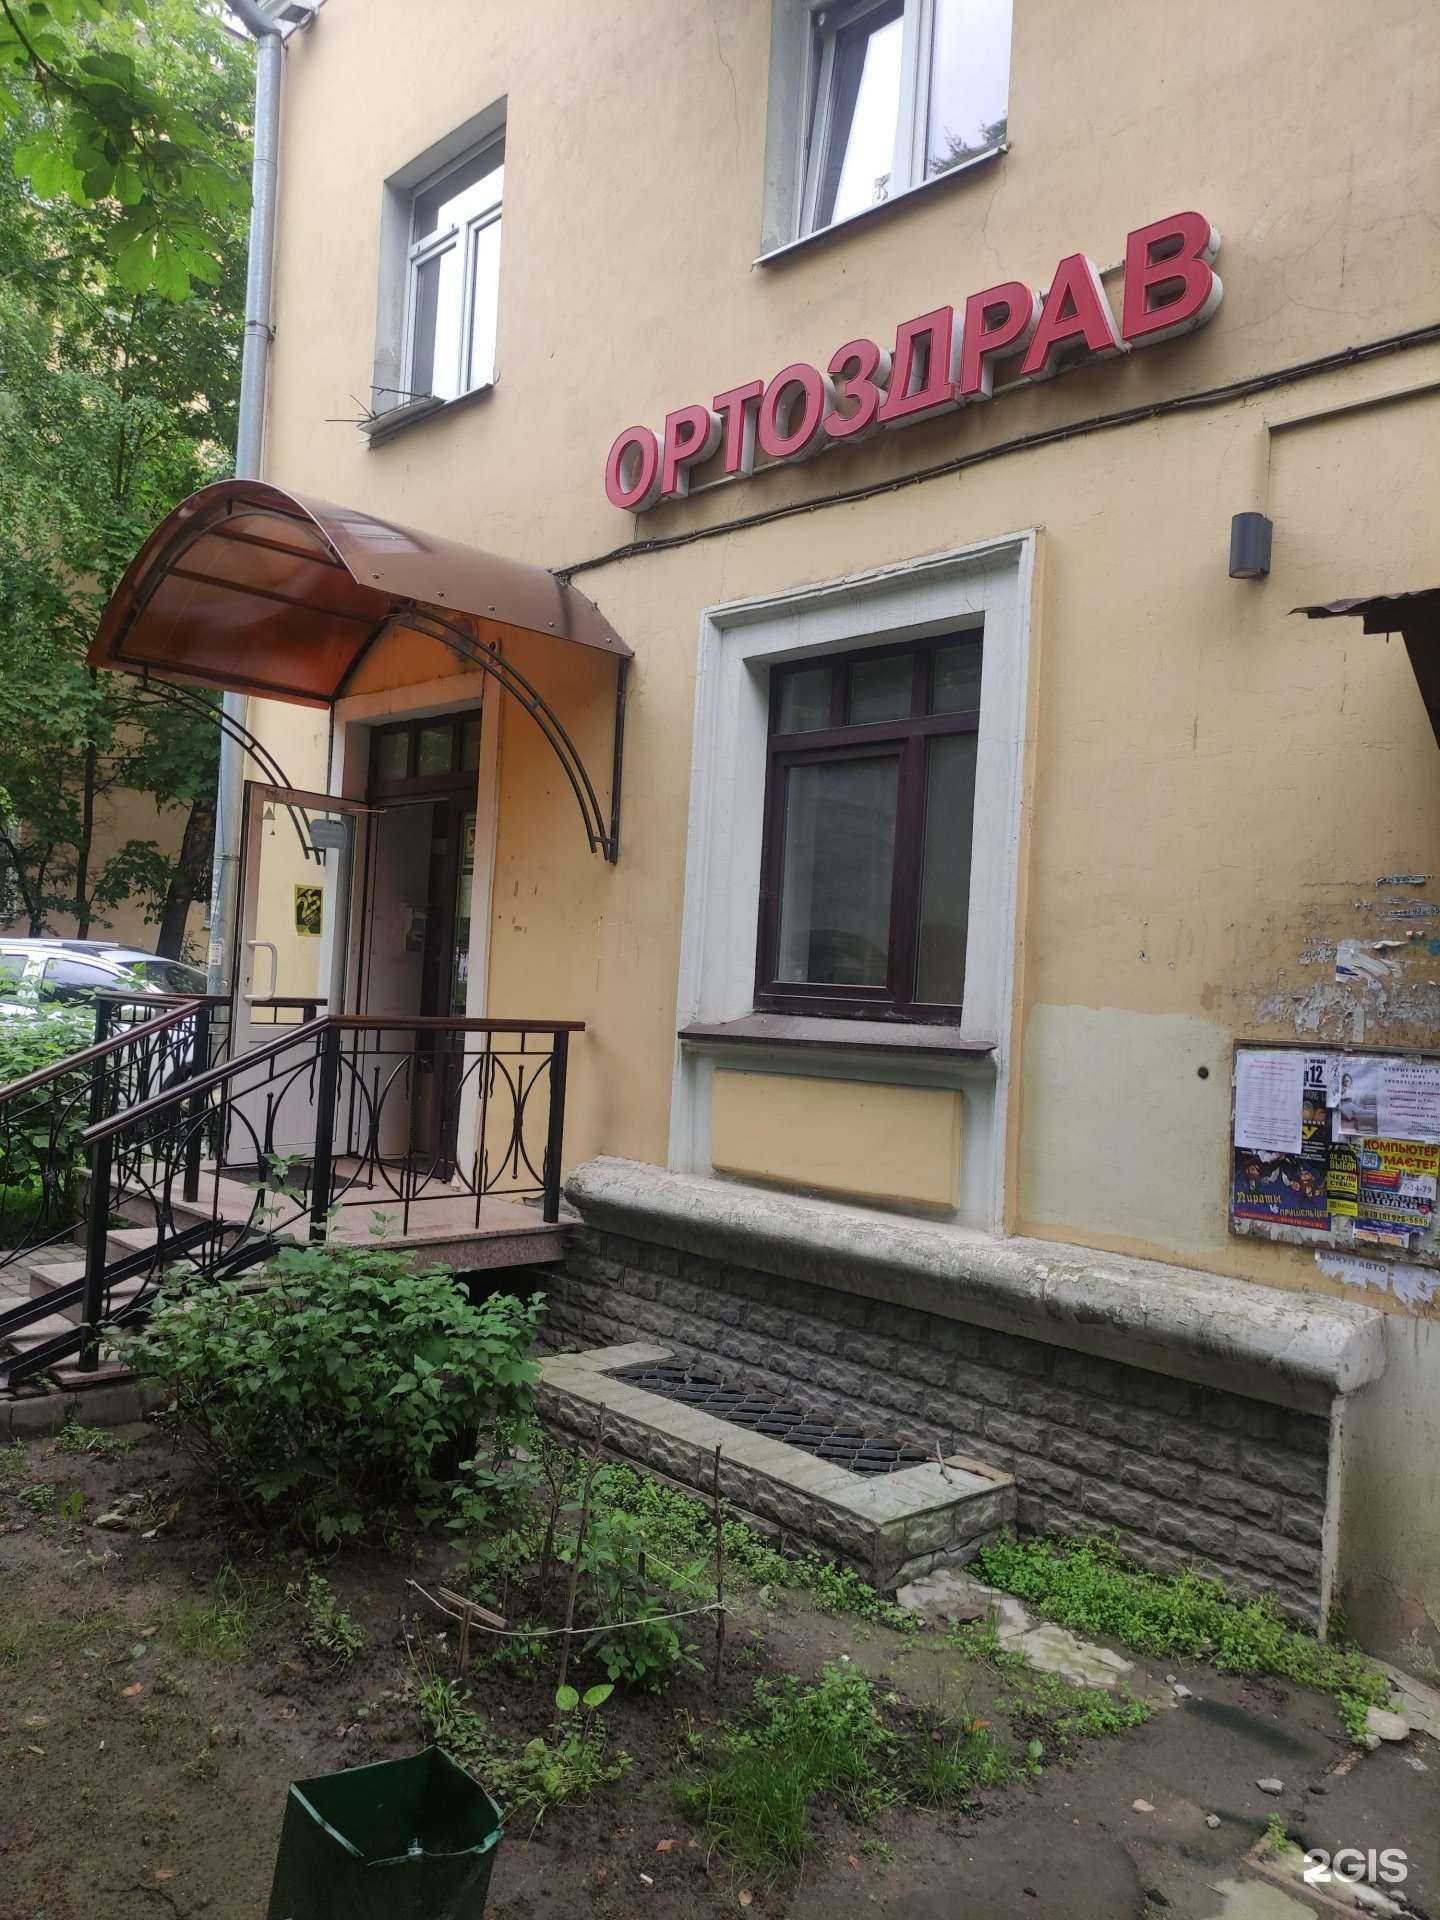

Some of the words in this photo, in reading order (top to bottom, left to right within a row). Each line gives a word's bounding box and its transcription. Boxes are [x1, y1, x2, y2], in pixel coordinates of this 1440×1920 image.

[605, 211, 1218, 510] ОРТОЗДРАВ
[1310, 1065, 1323, 1083] 12
[1384, 1155, 1437, 1170] МАСТЕР
[1358, 1261, 1387, 1273] АВТО
